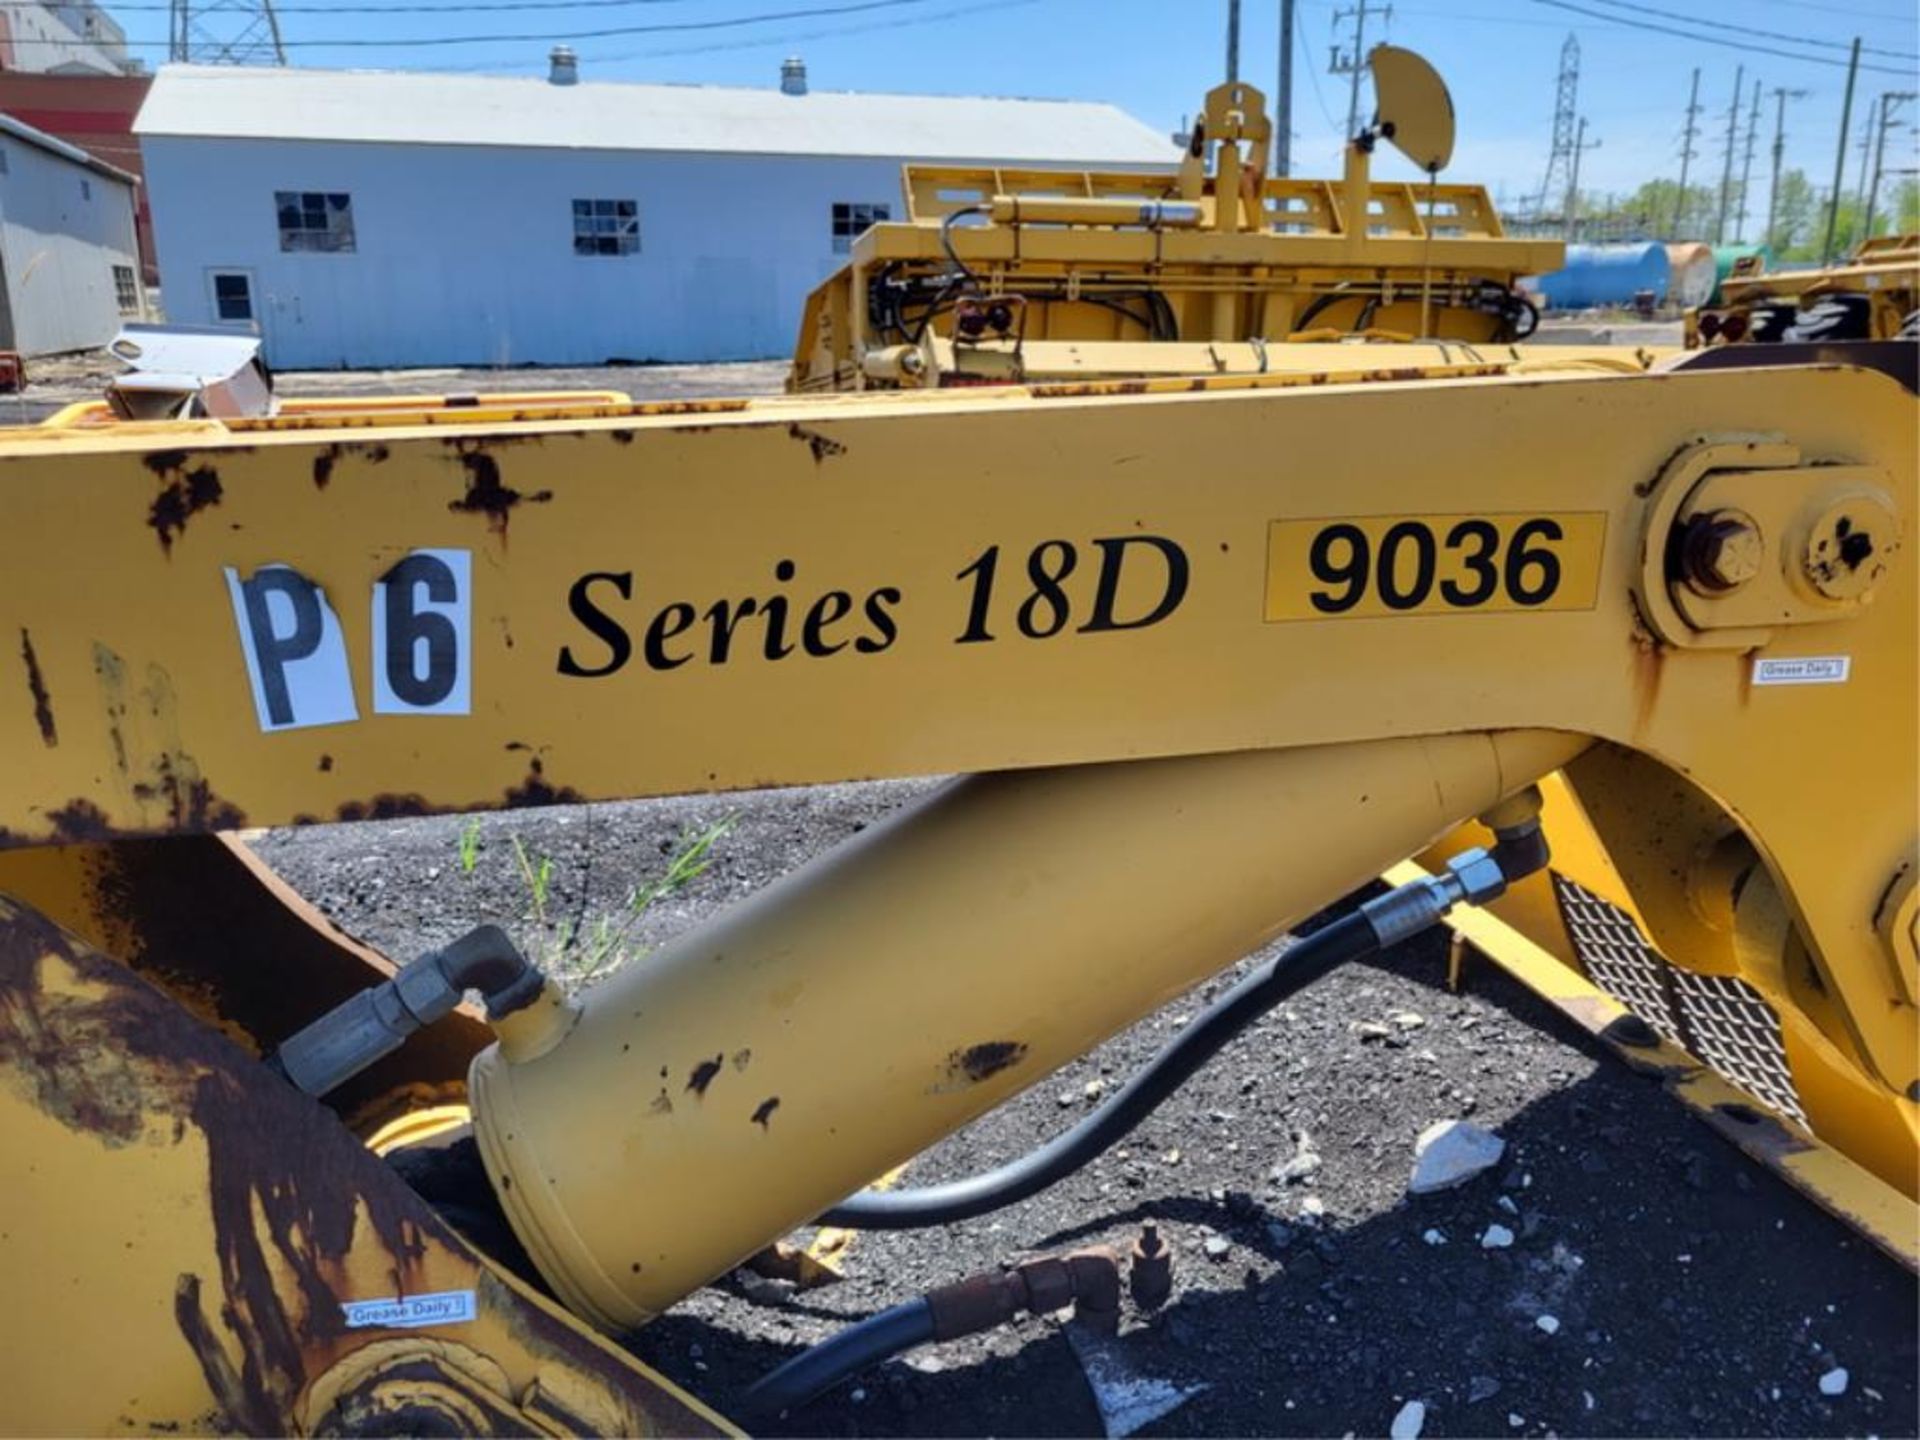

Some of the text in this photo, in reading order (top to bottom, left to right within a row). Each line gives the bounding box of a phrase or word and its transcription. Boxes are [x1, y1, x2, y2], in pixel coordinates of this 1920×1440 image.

[557, 535, 1189, 678] Series 18D
[1309, 518, 1563, 613] 9036
[354, 1307, 409, 1323] Grease
[413, 1299, 453, 1317] Daily
